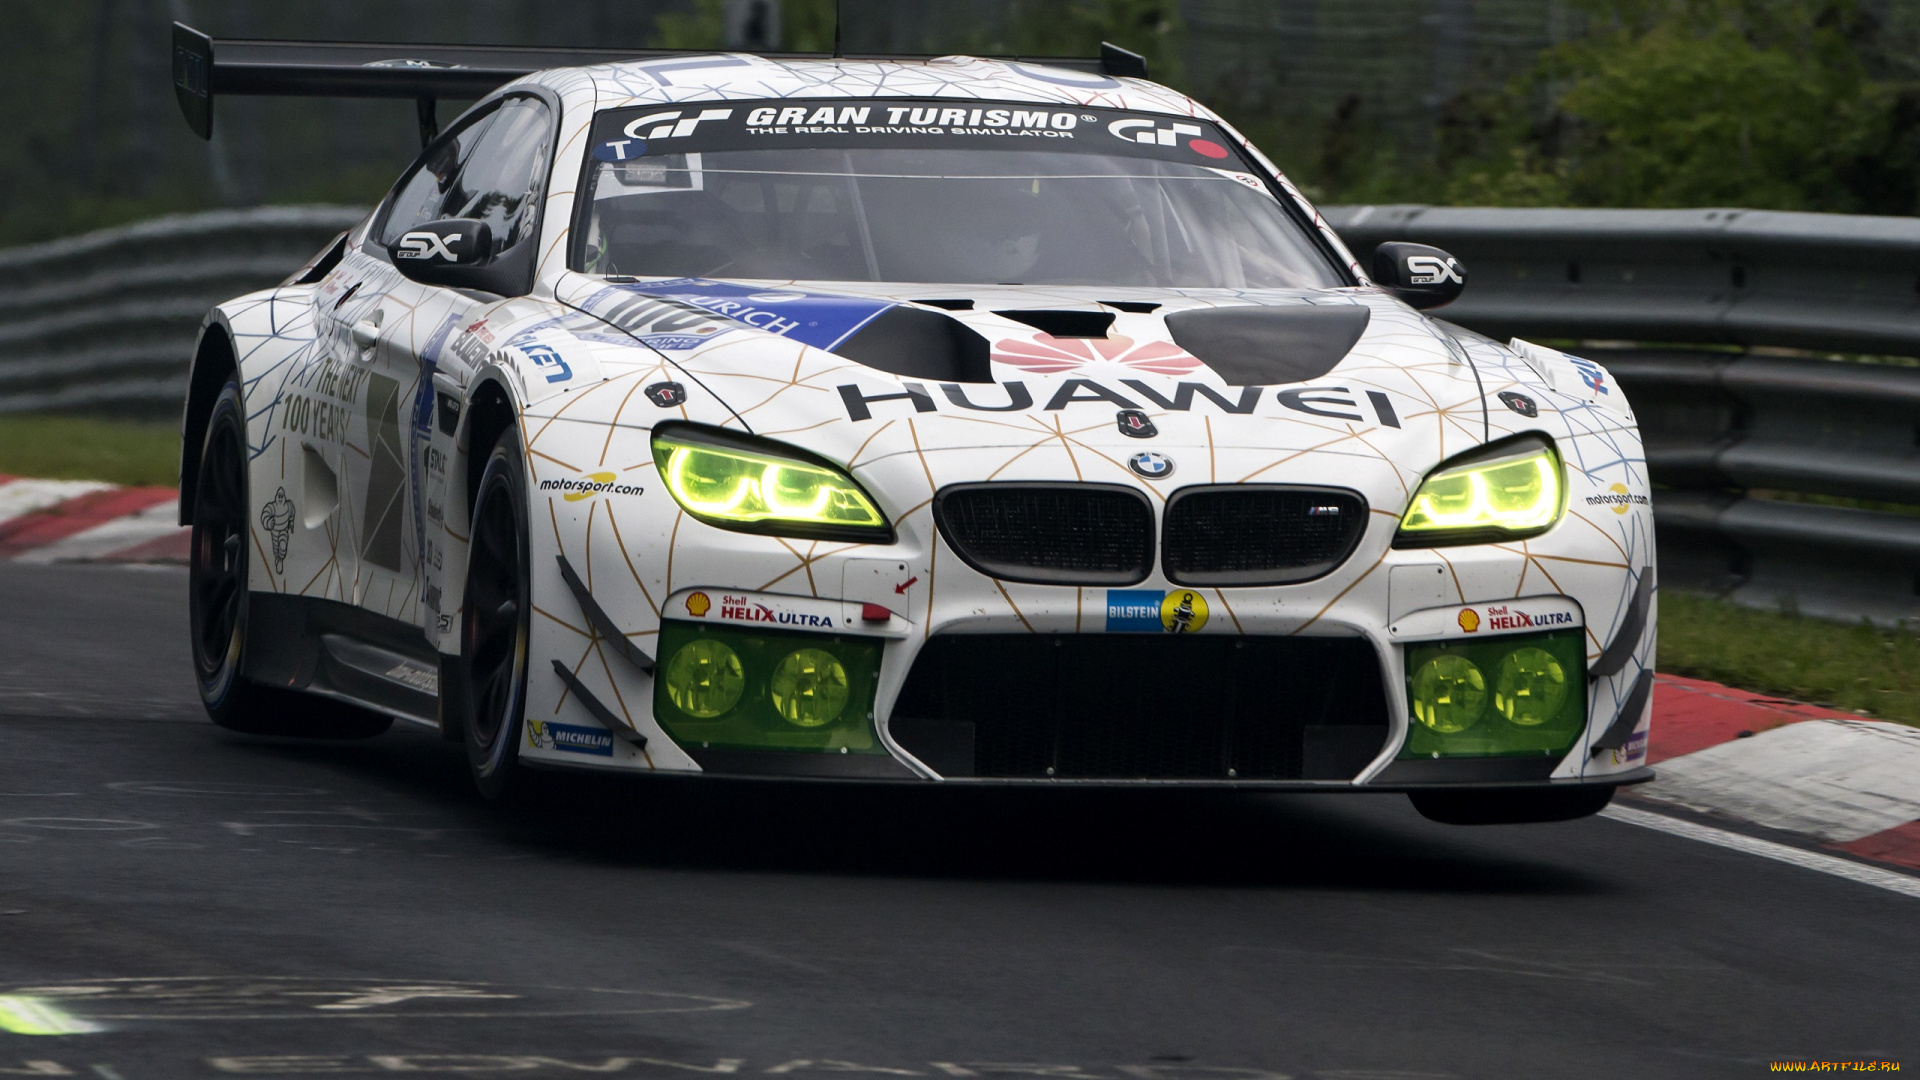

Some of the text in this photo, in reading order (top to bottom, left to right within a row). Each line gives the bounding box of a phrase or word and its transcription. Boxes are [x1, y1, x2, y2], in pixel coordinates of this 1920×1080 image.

[745, 107, 873, 126] GRAN
[746, 125, 1074, 139] THE REAL DRIVING SIMULATOR
[315, 356, 365, 405] THE NEXT
[836, 378, 1402, 430] HUAWEI
[282, 392, 347, 446] 100 YEARS
[540, 478, 645, 496] motorsport.com
[1585, 493, 1650, 507] motorsport.com
[722, 595, 747, 606] Shell
[721, 603, 833, 628] HELIX ULTRA
[1109, 605, 1159, 619] BILSTEIN
[1488, 605, 1508, 616] Shell
[1489, 610, 1573, 630] HELIX ULTRA
[555, 730, 612, 747] MICHELIN
